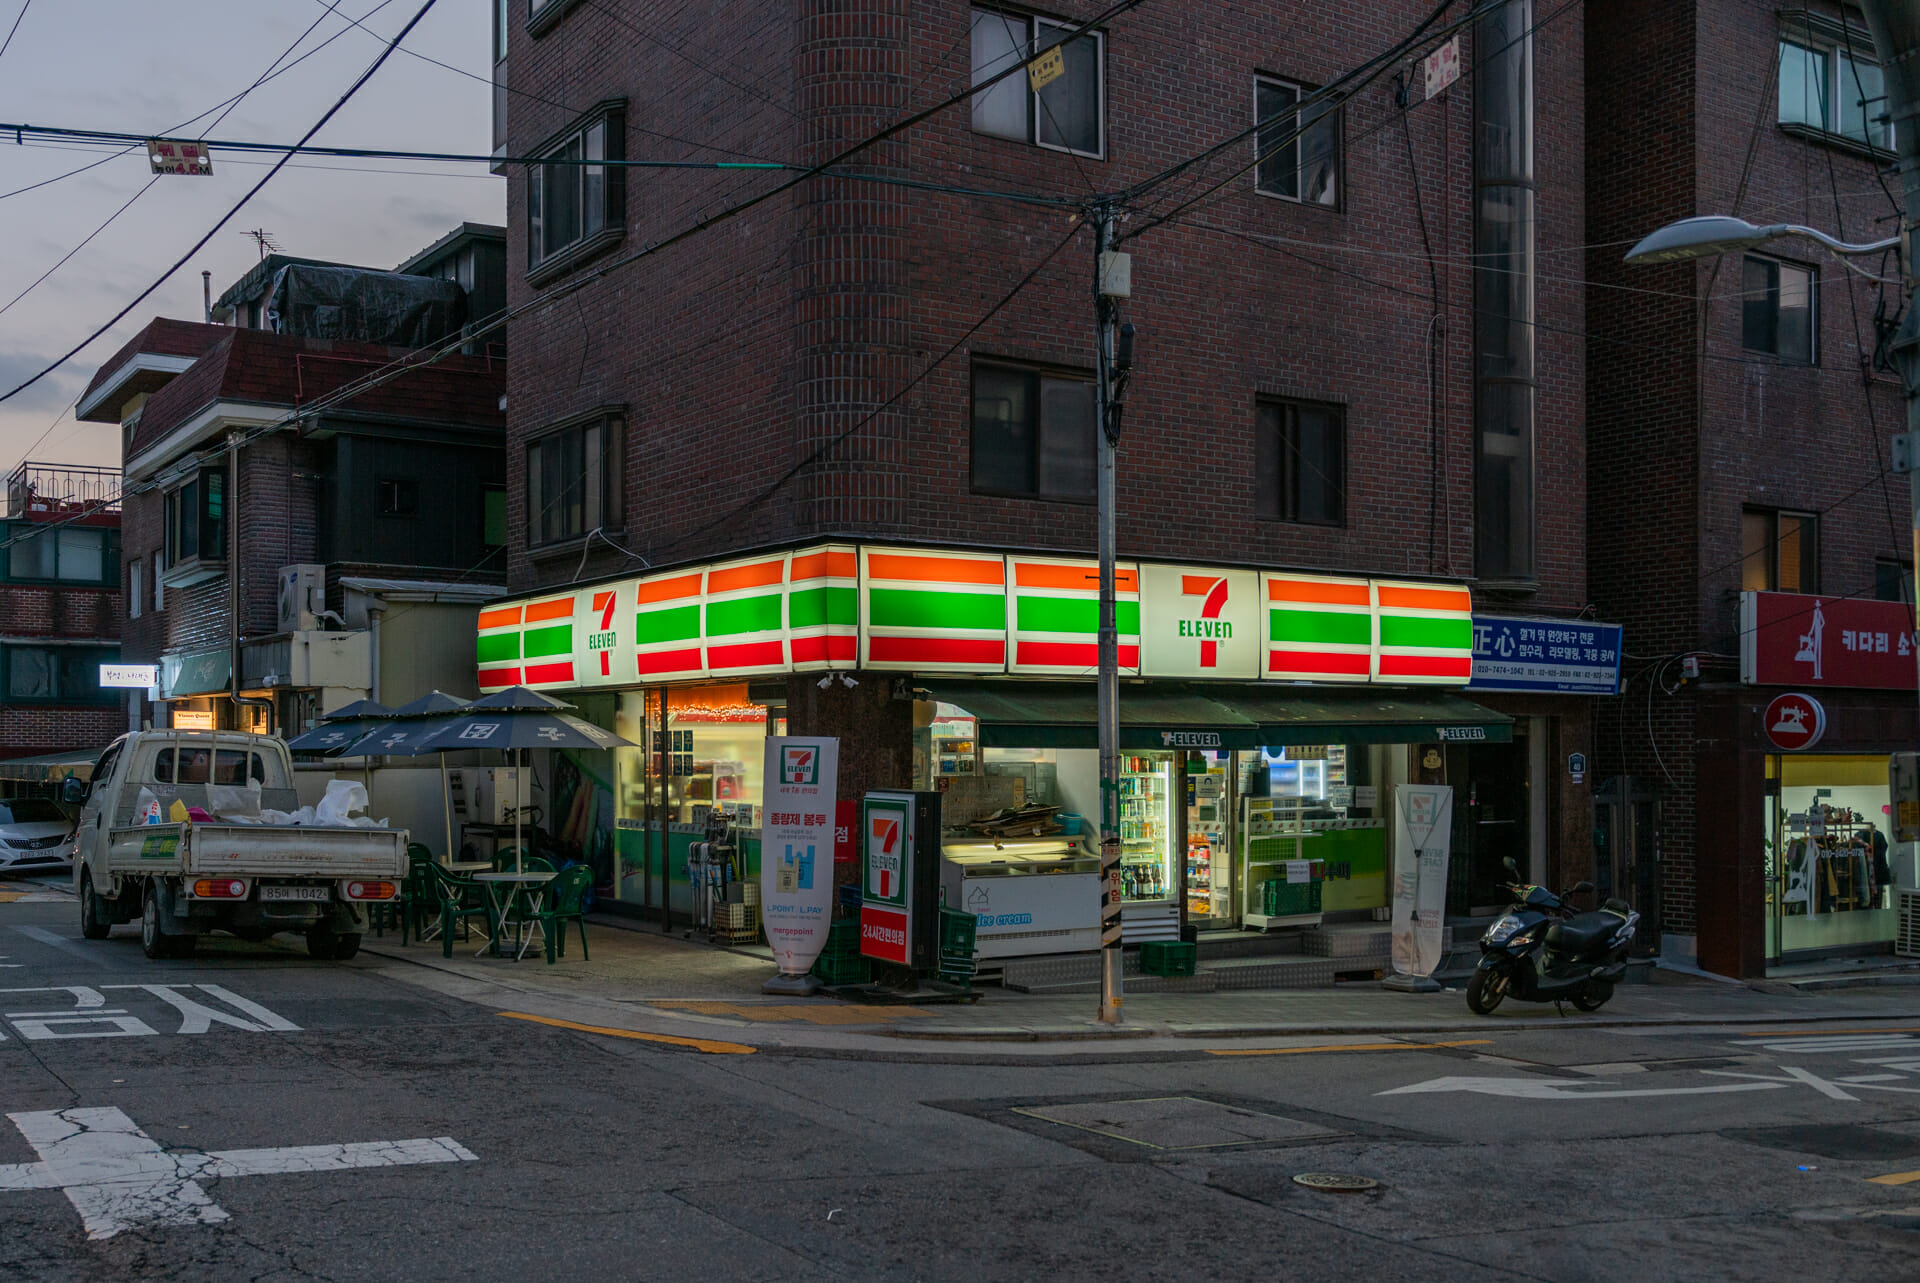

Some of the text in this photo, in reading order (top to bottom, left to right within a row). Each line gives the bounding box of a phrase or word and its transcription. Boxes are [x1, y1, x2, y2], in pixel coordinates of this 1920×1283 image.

[1519, 628, 1595, 646] 철거 및 원상복구 전문
[1841, 629, 1889, 655] 키다리
[1583, 648, 1598, 662] 각종
[1600, 649, 1616, 664] 공사
[771, 812, 801, 826] 종량제
[804, 812, 827, 827] 봉투
[995, 912, 1033, 926] cream
